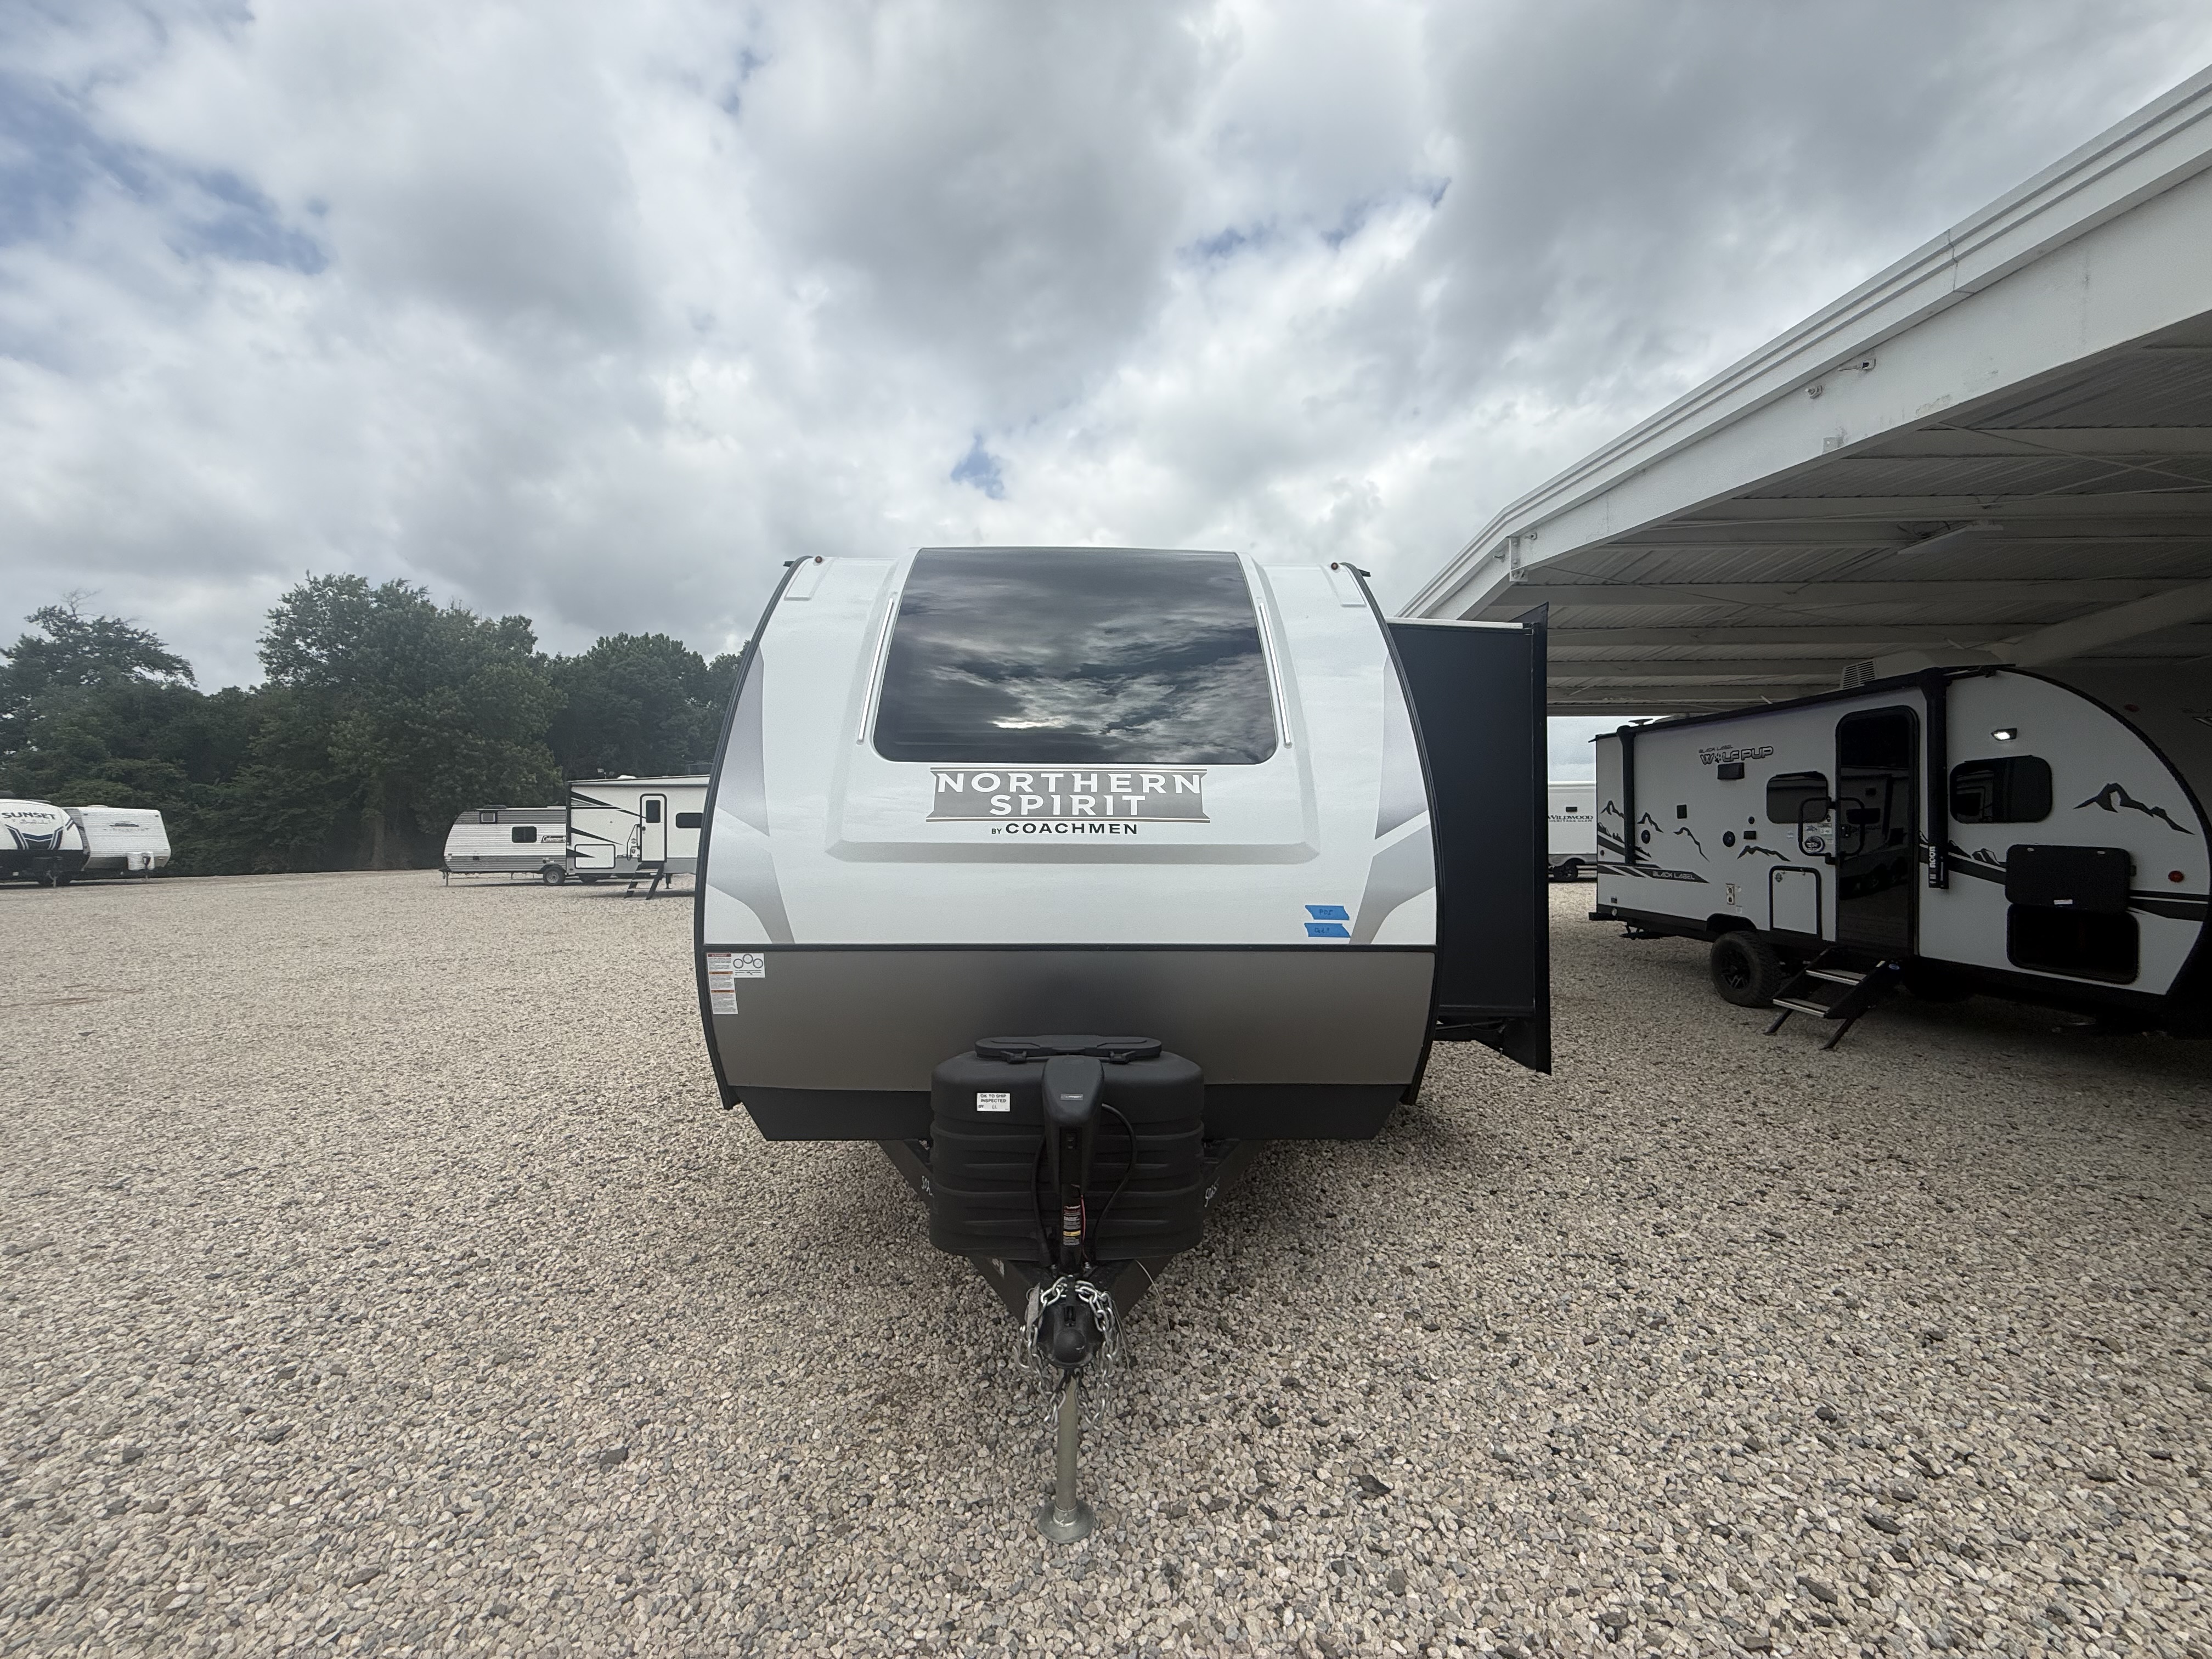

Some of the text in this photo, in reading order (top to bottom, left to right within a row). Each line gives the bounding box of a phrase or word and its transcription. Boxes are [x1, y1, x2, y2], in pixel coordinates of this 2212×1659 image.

[1701, 746, 1774, 765] WLF PUP
[936, 772, 1200, 794] NORTHERN
[989, 794, 1146, 816] SPIRIT
[1006, 823, 1137, 834] COACHMEN
